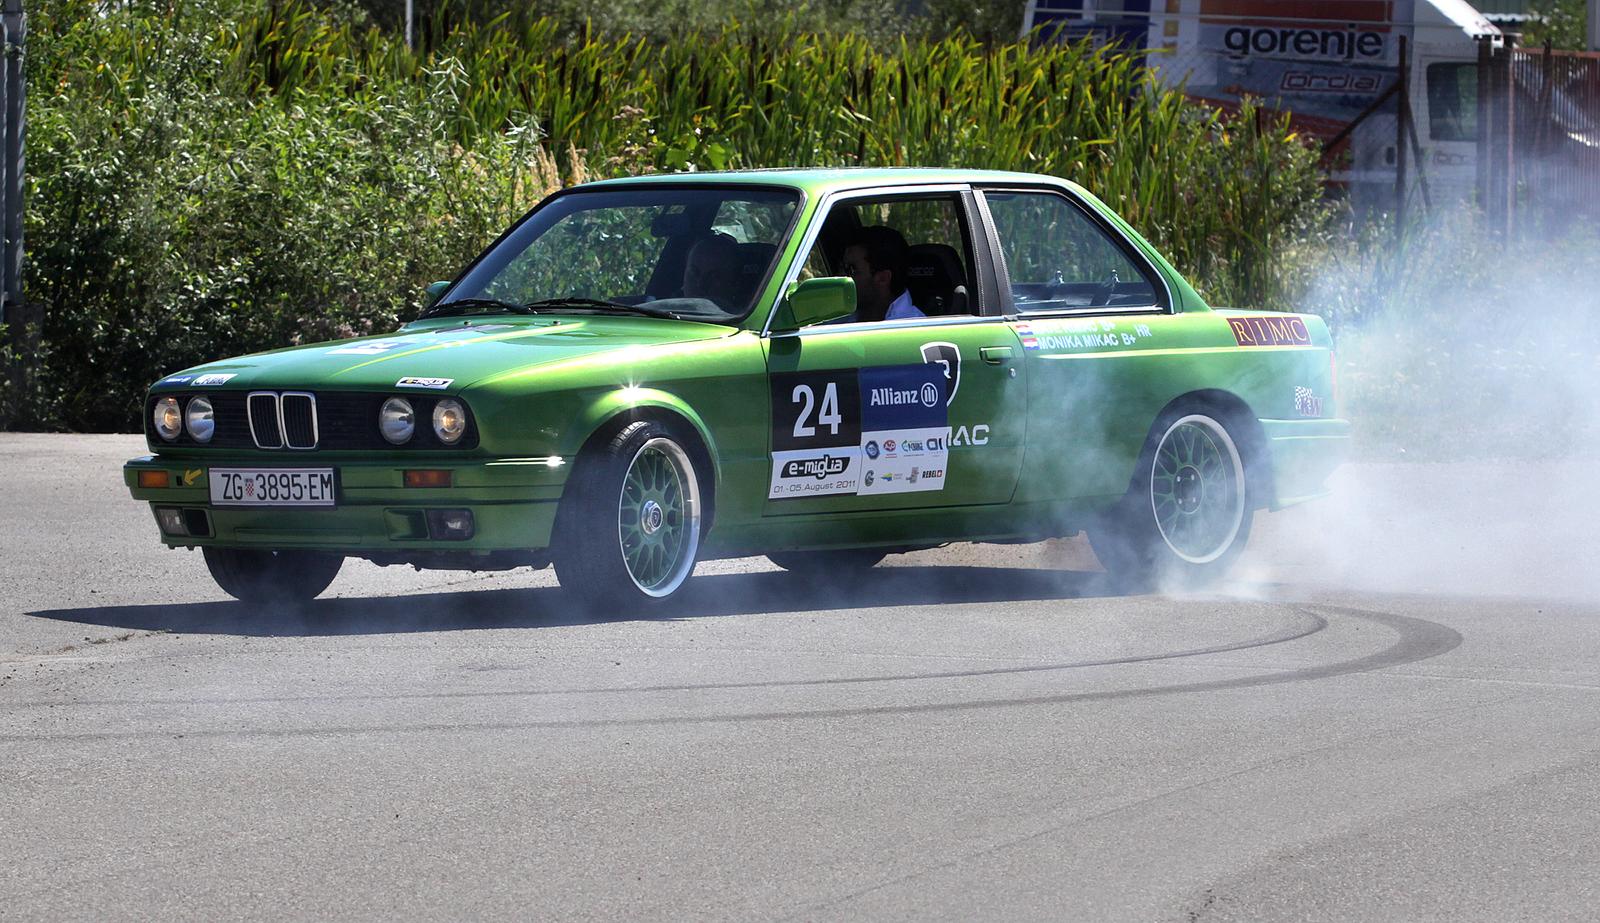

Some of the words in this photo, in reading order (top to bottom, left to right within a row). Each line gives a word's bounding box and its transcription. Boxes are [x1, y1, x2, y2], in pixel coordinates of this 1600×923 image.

[1224, 24, 1383, 60] gorenje
[1040, 334, 1083, 349] MONIKA
[1121, 333, 1136, 345] B+
[1134, 323, 1152, 337] HR
[1232, 320, 1307, 342] RIMC
[870, 388, 919, 406] Allianz
[792, 382, 842, 438] 24
[788, 456, 843, 478] e-miglia
[221, 473, 243, 500] ZG
[835, 480, 856, 489] 2011
